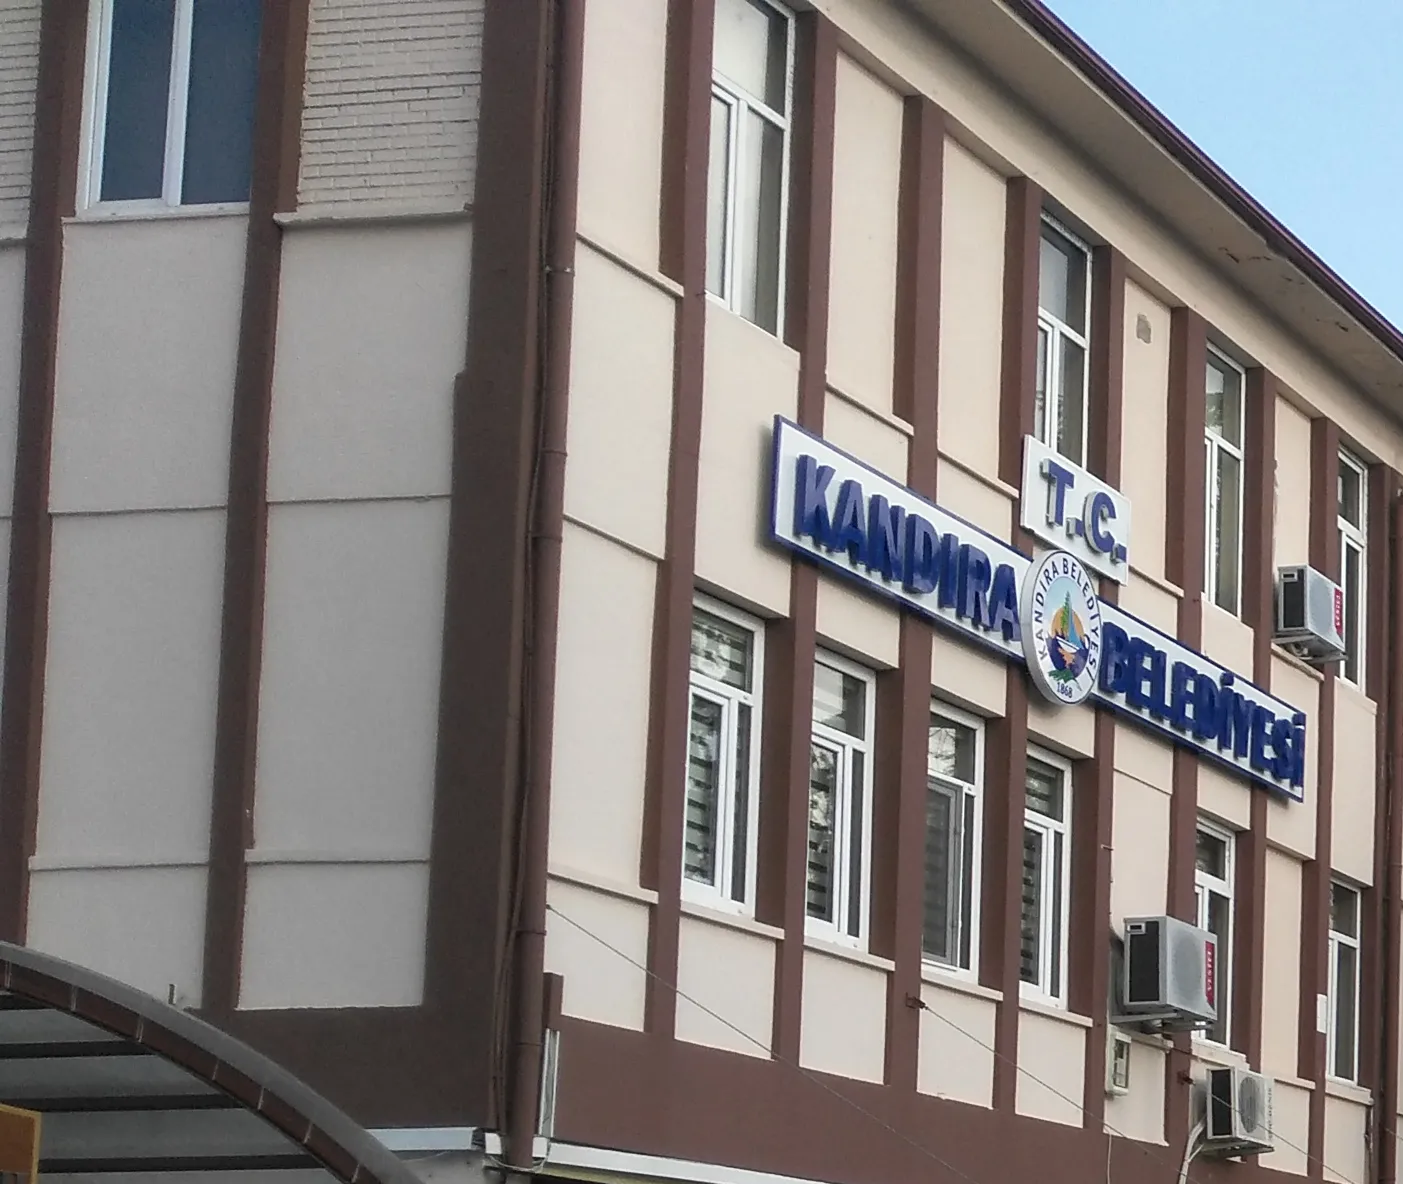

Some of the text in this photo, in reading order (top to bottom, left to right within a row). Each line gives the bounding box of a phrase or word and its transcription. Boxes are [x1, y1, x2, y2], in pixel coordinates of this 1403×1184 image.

[1039, 458, 1127, 563] T.C.
[793, 454, 1306, 788] KANDIRA BELEDİYESİ
[1032, 560, 1059, 661] KANDIRA
[1056, 681, 1074, 699] 1868
